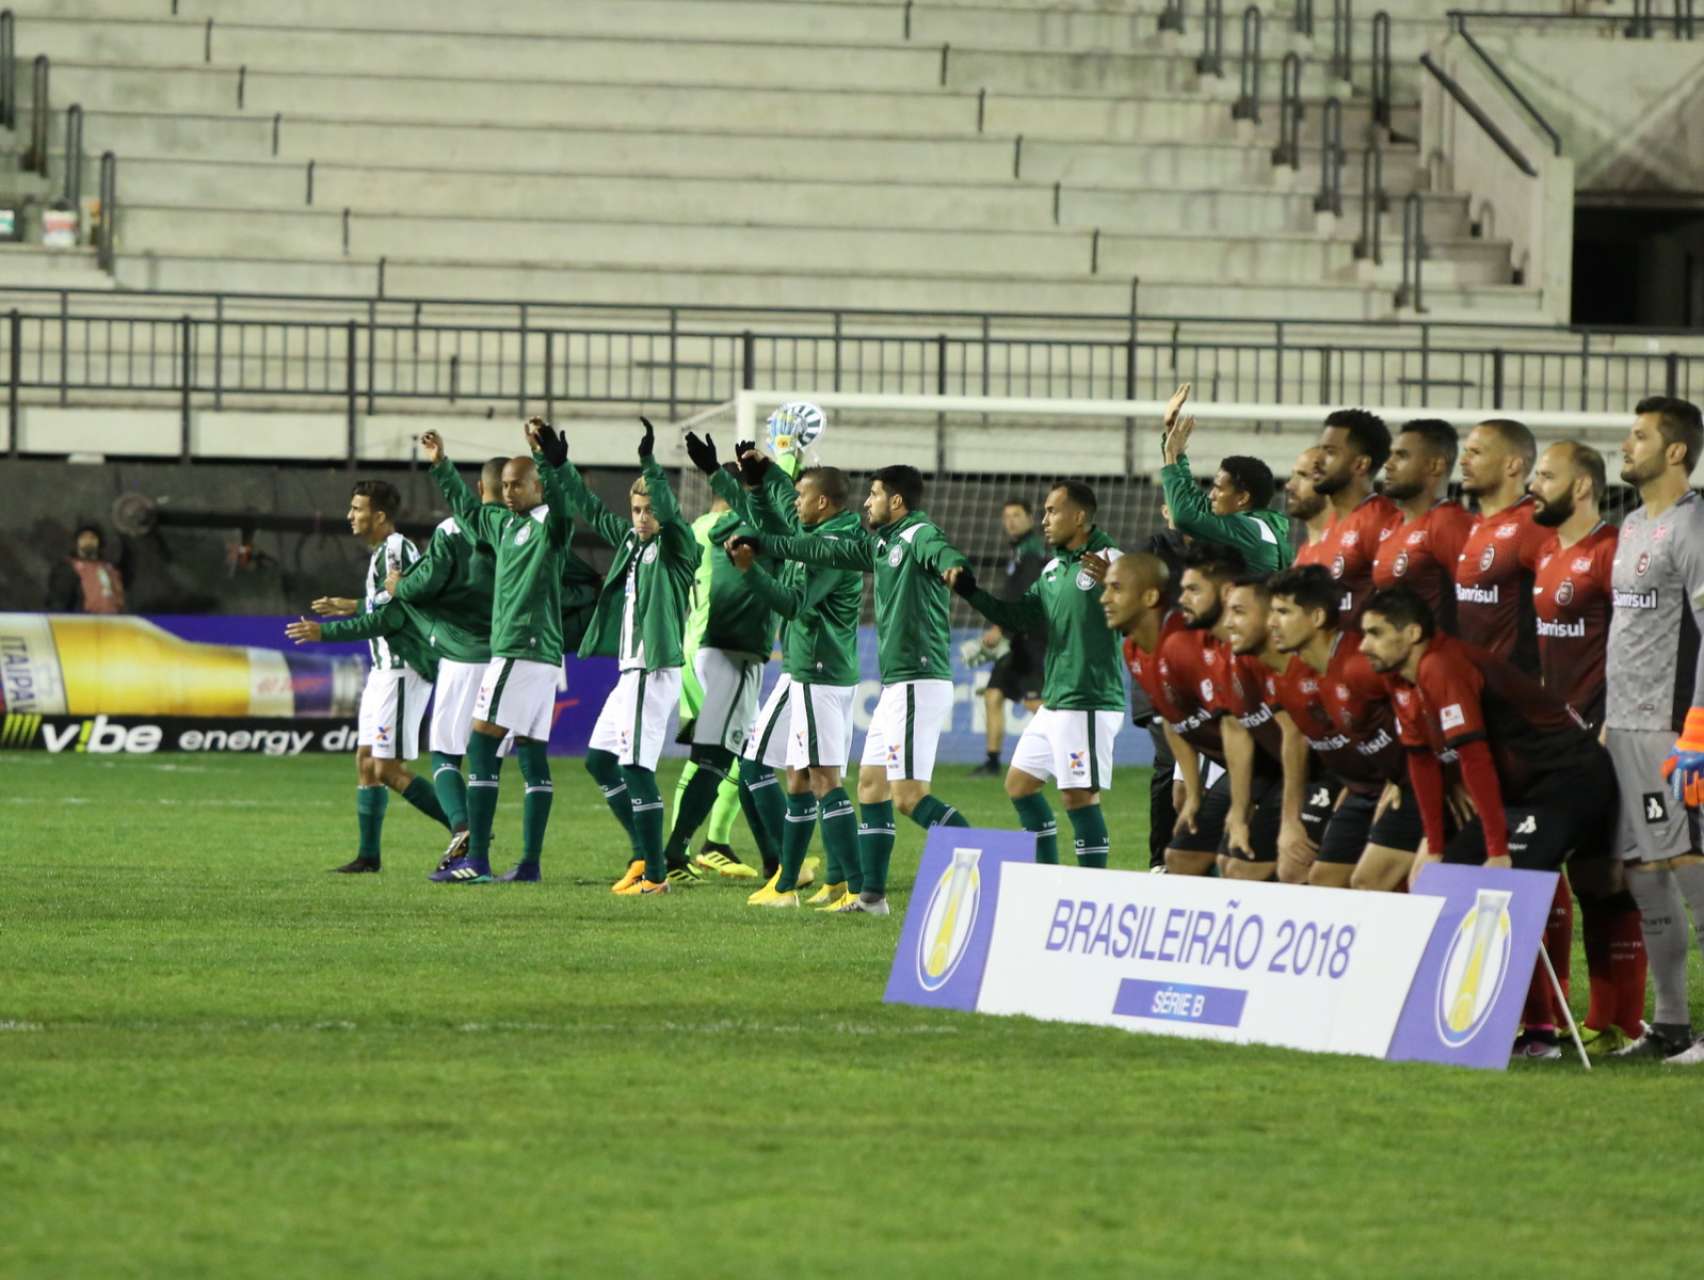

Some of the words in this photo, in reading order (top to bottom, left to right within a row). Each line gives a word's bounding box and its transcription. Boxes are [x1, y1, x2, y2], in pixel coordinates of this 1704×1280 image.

[178, 729, 313, 756] energy
[322, 725, 360, 751] dr
[1045, 898, 1263, 971] BRASILEIRÃO
[1267, 919, 1356, 979] 2018
[1151, 986, 1192, 1016] SÉRIE
[1191, 994, 1205, 1018] B
